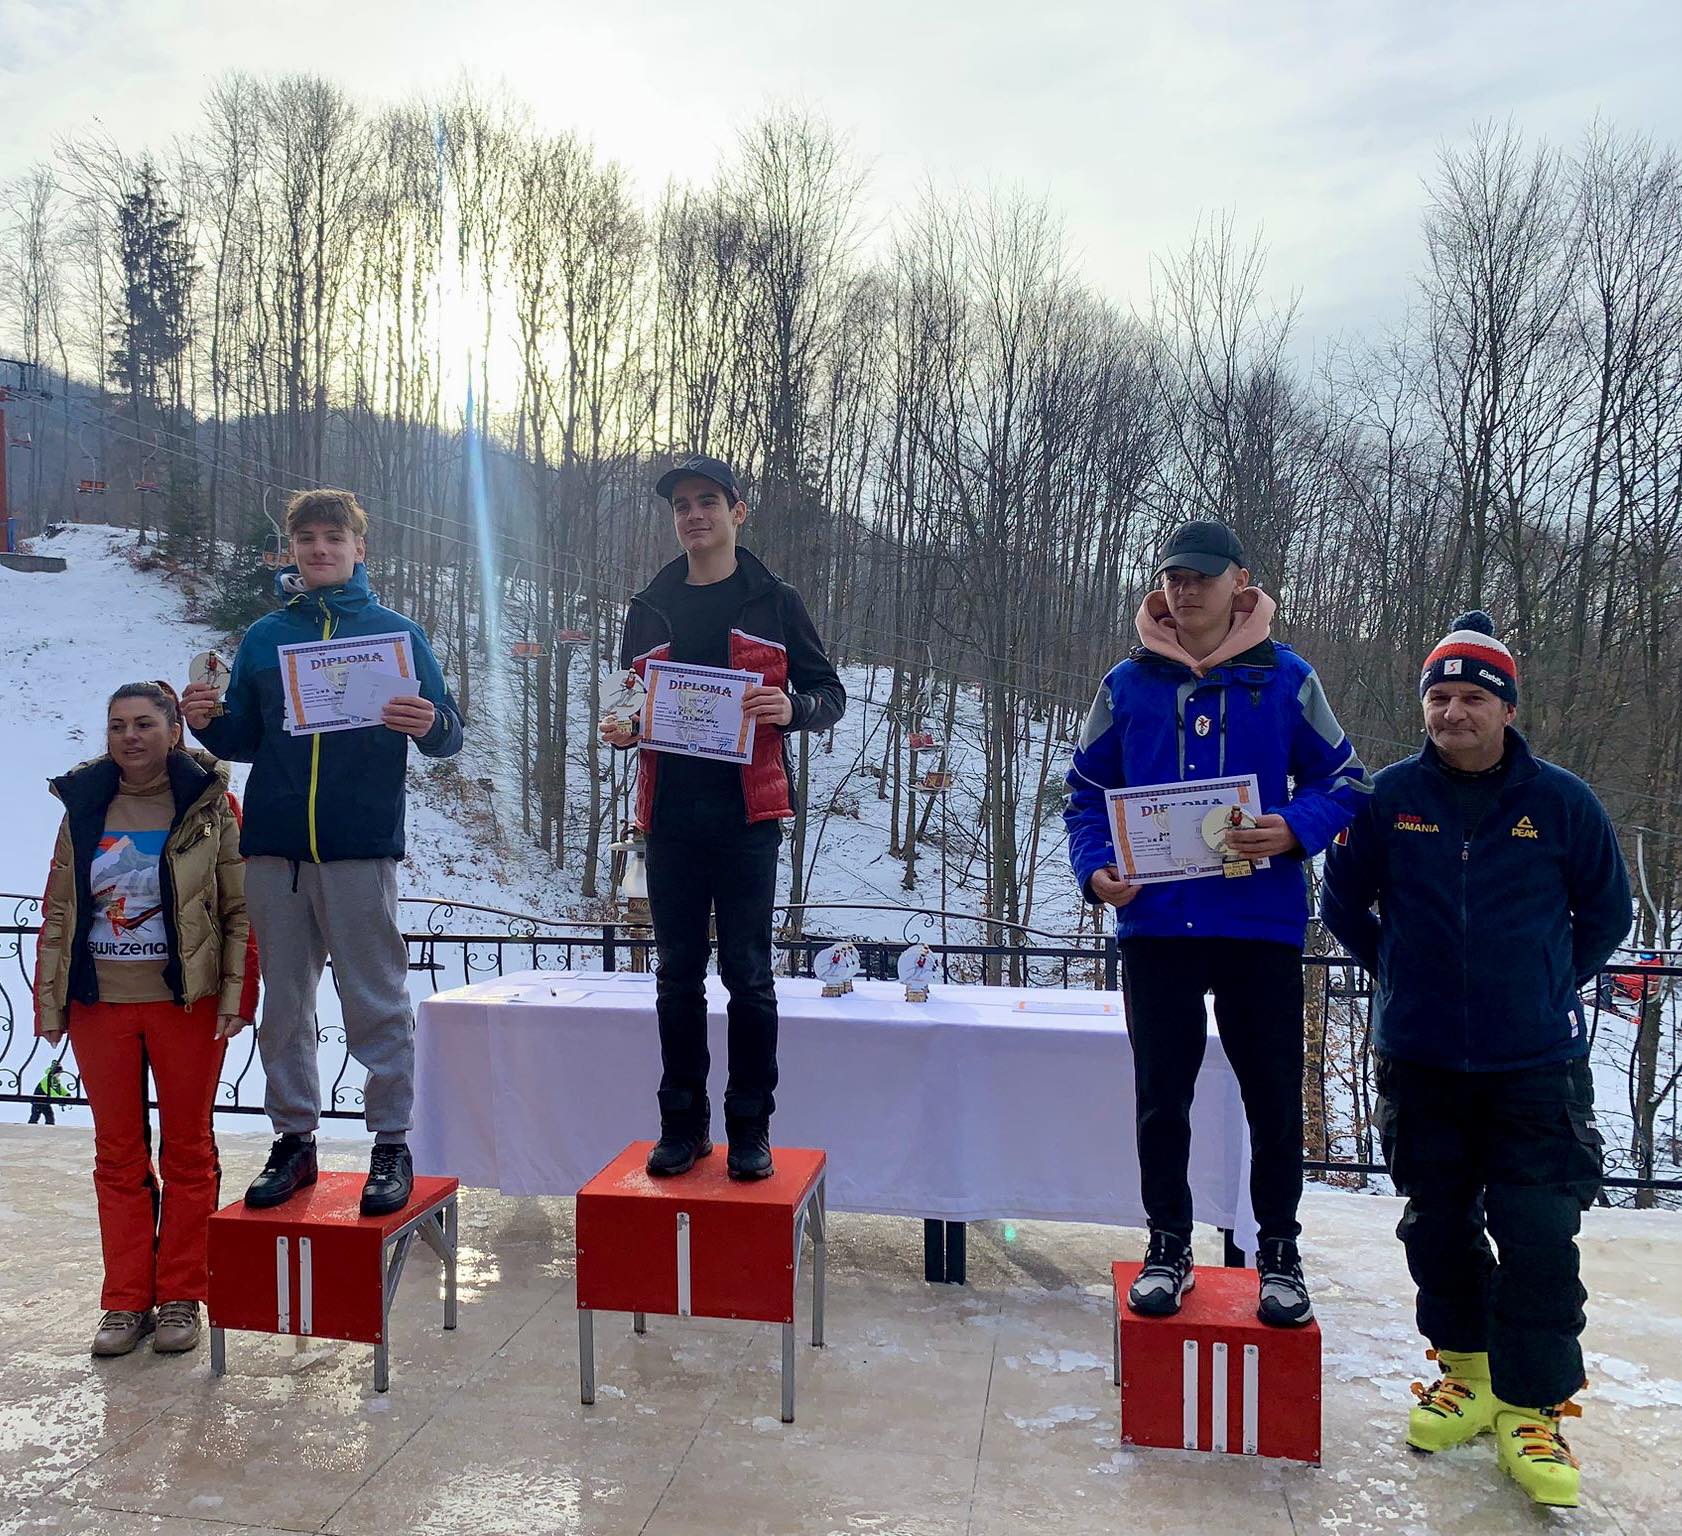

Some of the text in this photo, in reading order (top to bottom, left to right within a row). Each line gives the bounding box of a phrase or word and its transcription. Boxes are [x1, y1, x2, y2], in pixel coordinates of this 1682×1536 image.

[310, 652, 385, 670] DIPLOMA
[668, 679, 732, 698] DIPLOMA
[1511, 828, 1539, 839] PEAK
